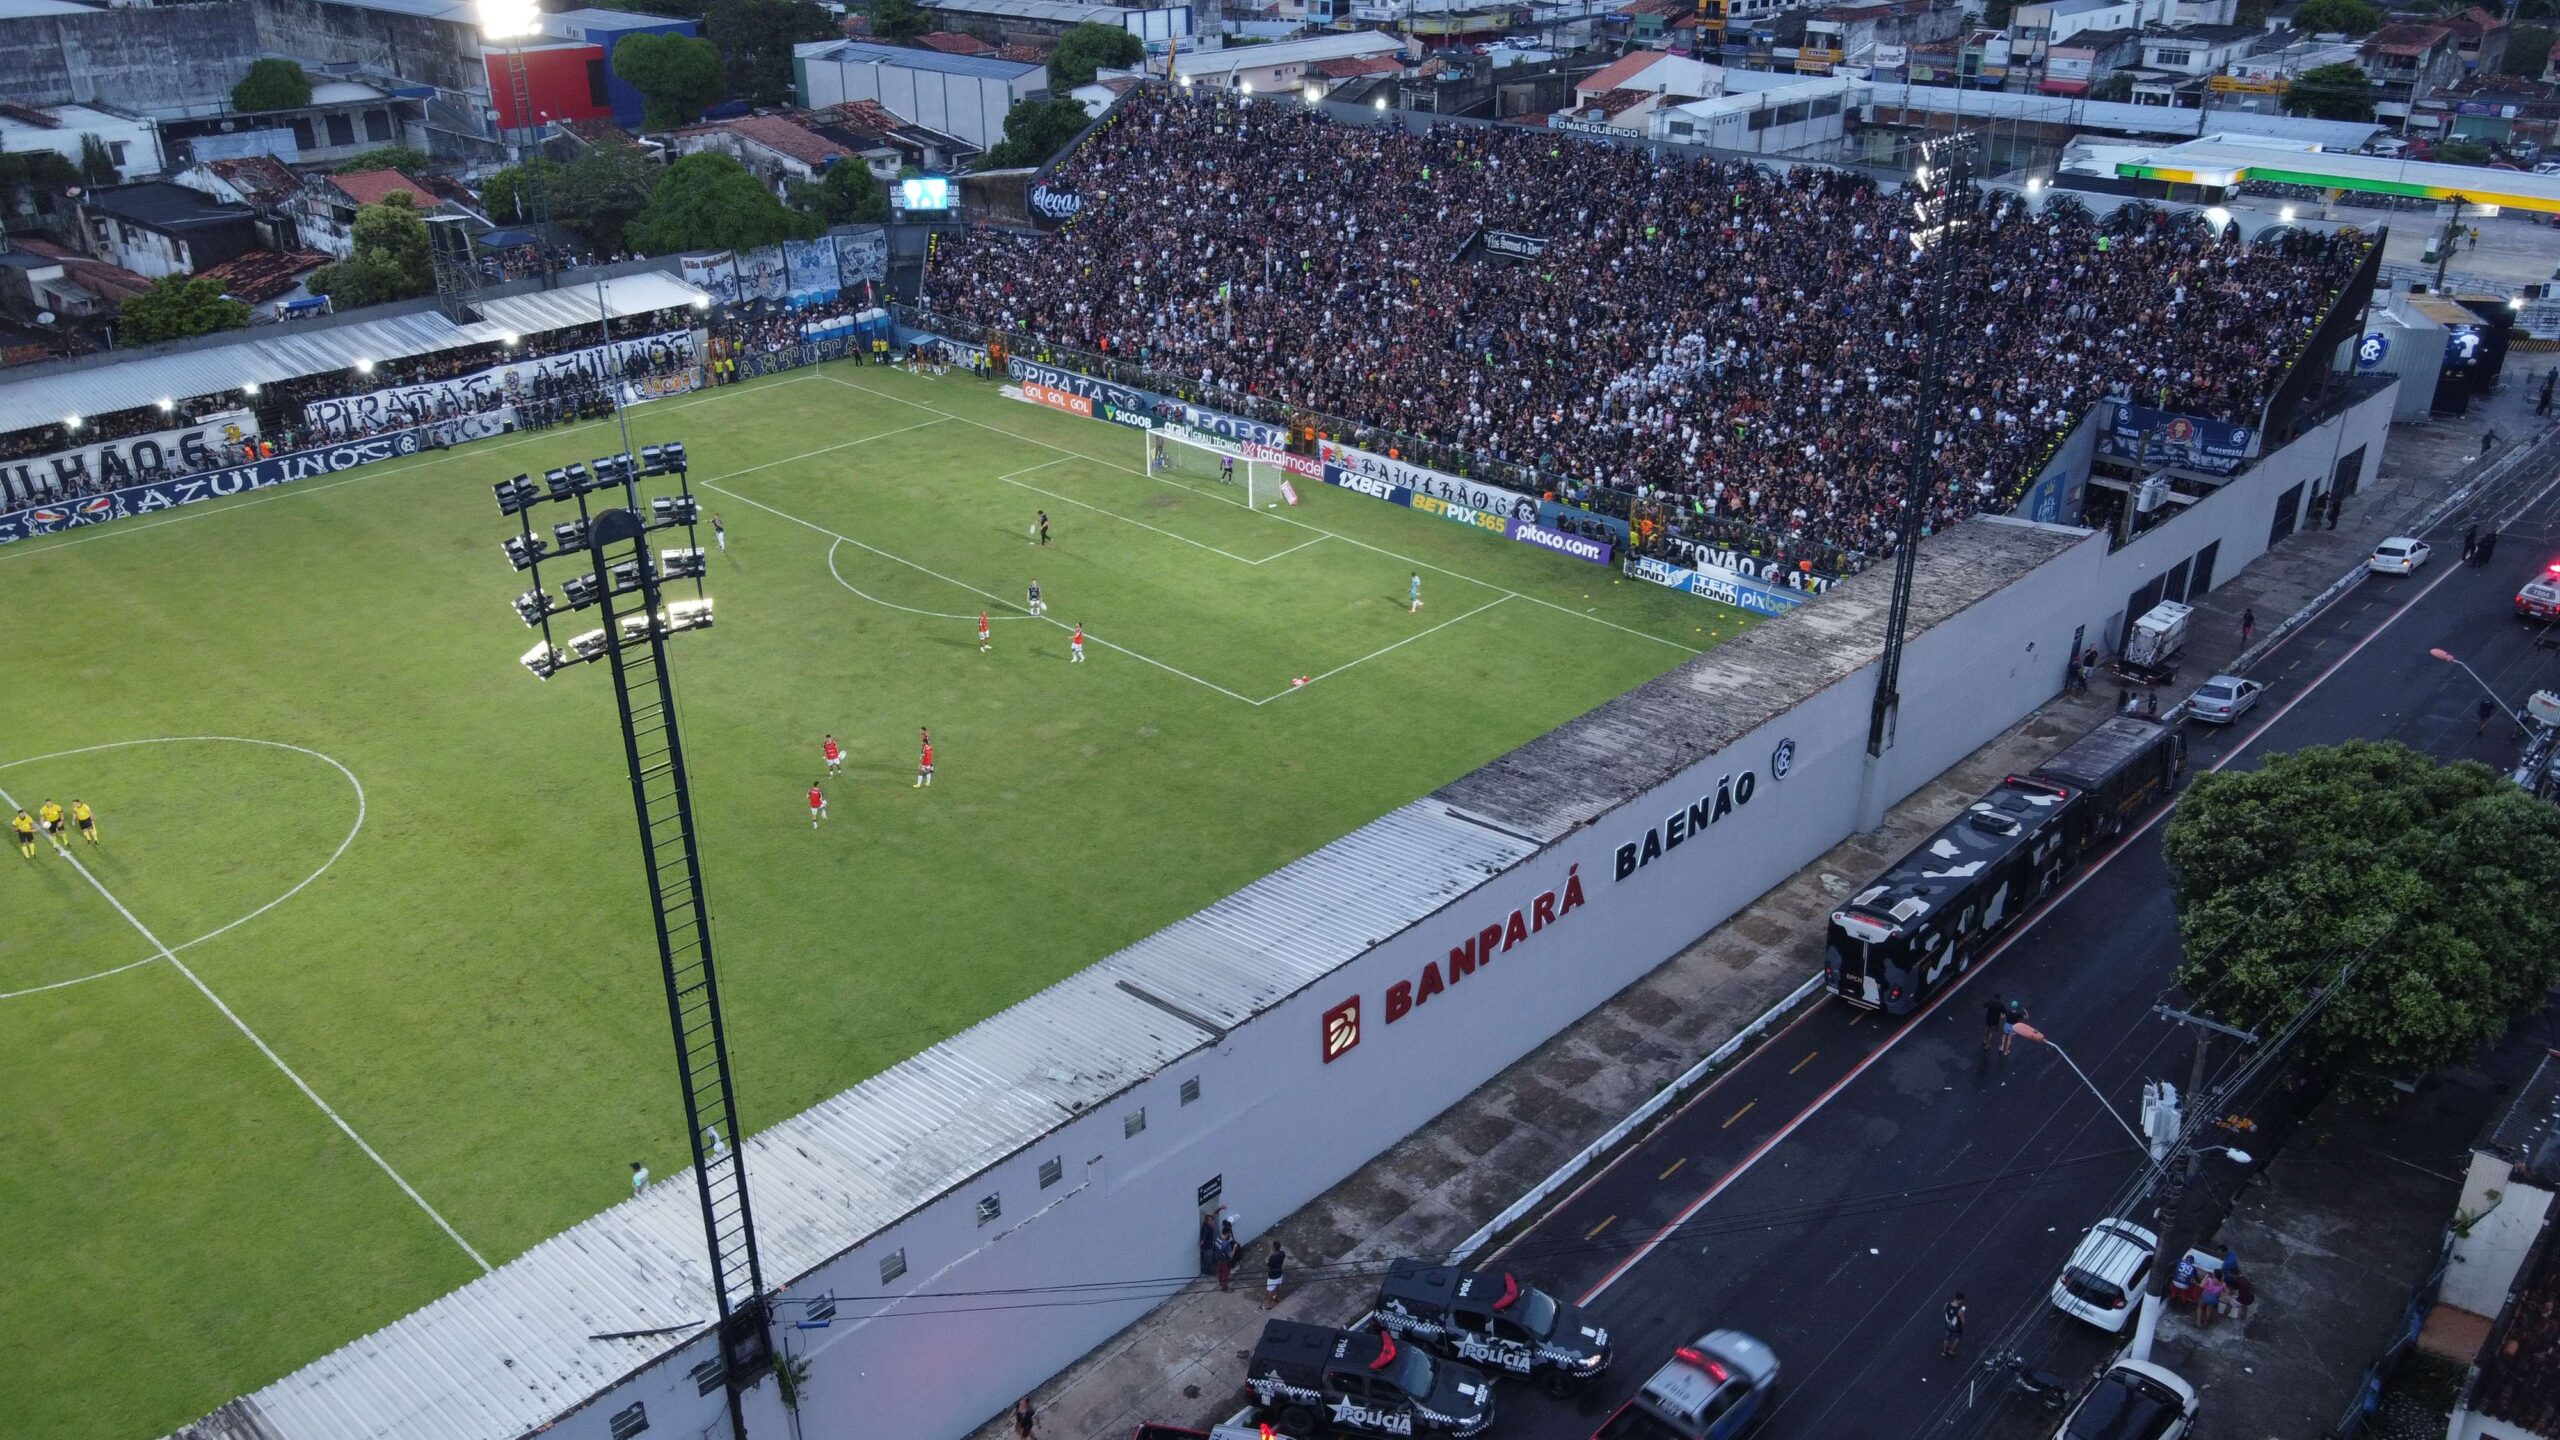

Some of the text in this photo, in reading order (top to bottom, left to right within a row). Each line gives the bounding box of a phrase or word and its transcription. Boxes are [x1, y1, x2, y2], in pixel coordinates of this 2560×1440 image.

[1558, 121, 1639, 138] O MAIS QUERIDO
[1025, 385, 1089, 413] GOL GOL GOL
[1115, 410, 1152, 429] SICOOB
[1193, 430, 1241, 453] GRAU TÉCNICO
[138, 440, 394, 513] AZULINOS
[1339, 471, 1395, 500] 1XBET
[1413, 493, 1505, 533] BETPIX365
[1515, 525, 1600, 560] pitaco.com
[1638, 557, 1666, 574] EK
[1693, 584, 1736, 604] BOND
[1697, 576, 1736, 595] TEK
[1614, 770, 1755, 882] BAENÃO
[1385, 863, 1585, 1024] BANPARÁ
[2178, 1262, 2194, 1276] 39
[1459, 1278, 1472, 1297] 7904
[1465, 1344, 1531, 1370] POLÍCIA
[1343, 1406, 1411, 1432] POLÍCIA
